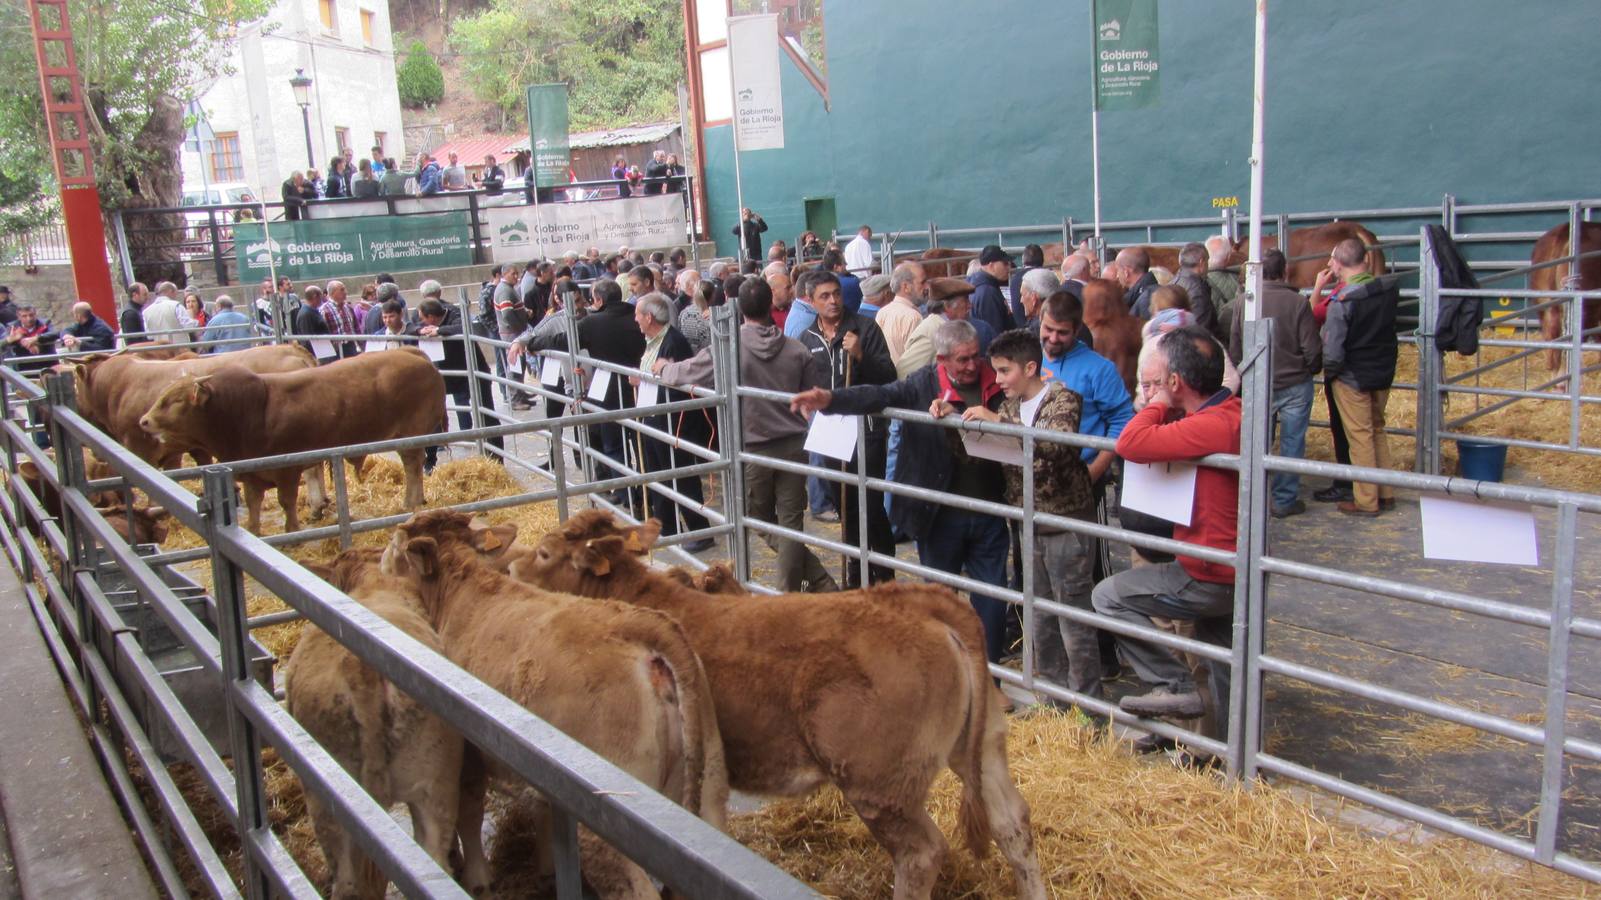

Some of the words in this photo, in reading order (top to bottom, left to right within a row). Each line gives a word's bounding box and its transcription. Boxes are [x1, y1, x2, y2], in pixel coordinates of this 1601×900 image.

[1100, 50, 1148, 60] Gobierno
[1101, 63, 1114, 72] de
[1117, 62, 1130, 71] La
[1133, 61, 1158, 72] Rioja
[740, 108, 773, 116] Gobierno
[762, 115, 781, 123] Rioja
[1212, 196, 1239, 208] PASA
[551, 234, 564, 244] La
[566, 233, 590, 244] Rioja
[287, 242, 342, 254] Gobierno
[289, 254, 304, 266] de
[307, 253, 322, 265] La
[325, 252, 354, 264] Rioja
[371, 252, 377, 262] y
[378, 248, 420, 259] Desarrollo
[422, 247, 444, 255] Rural
